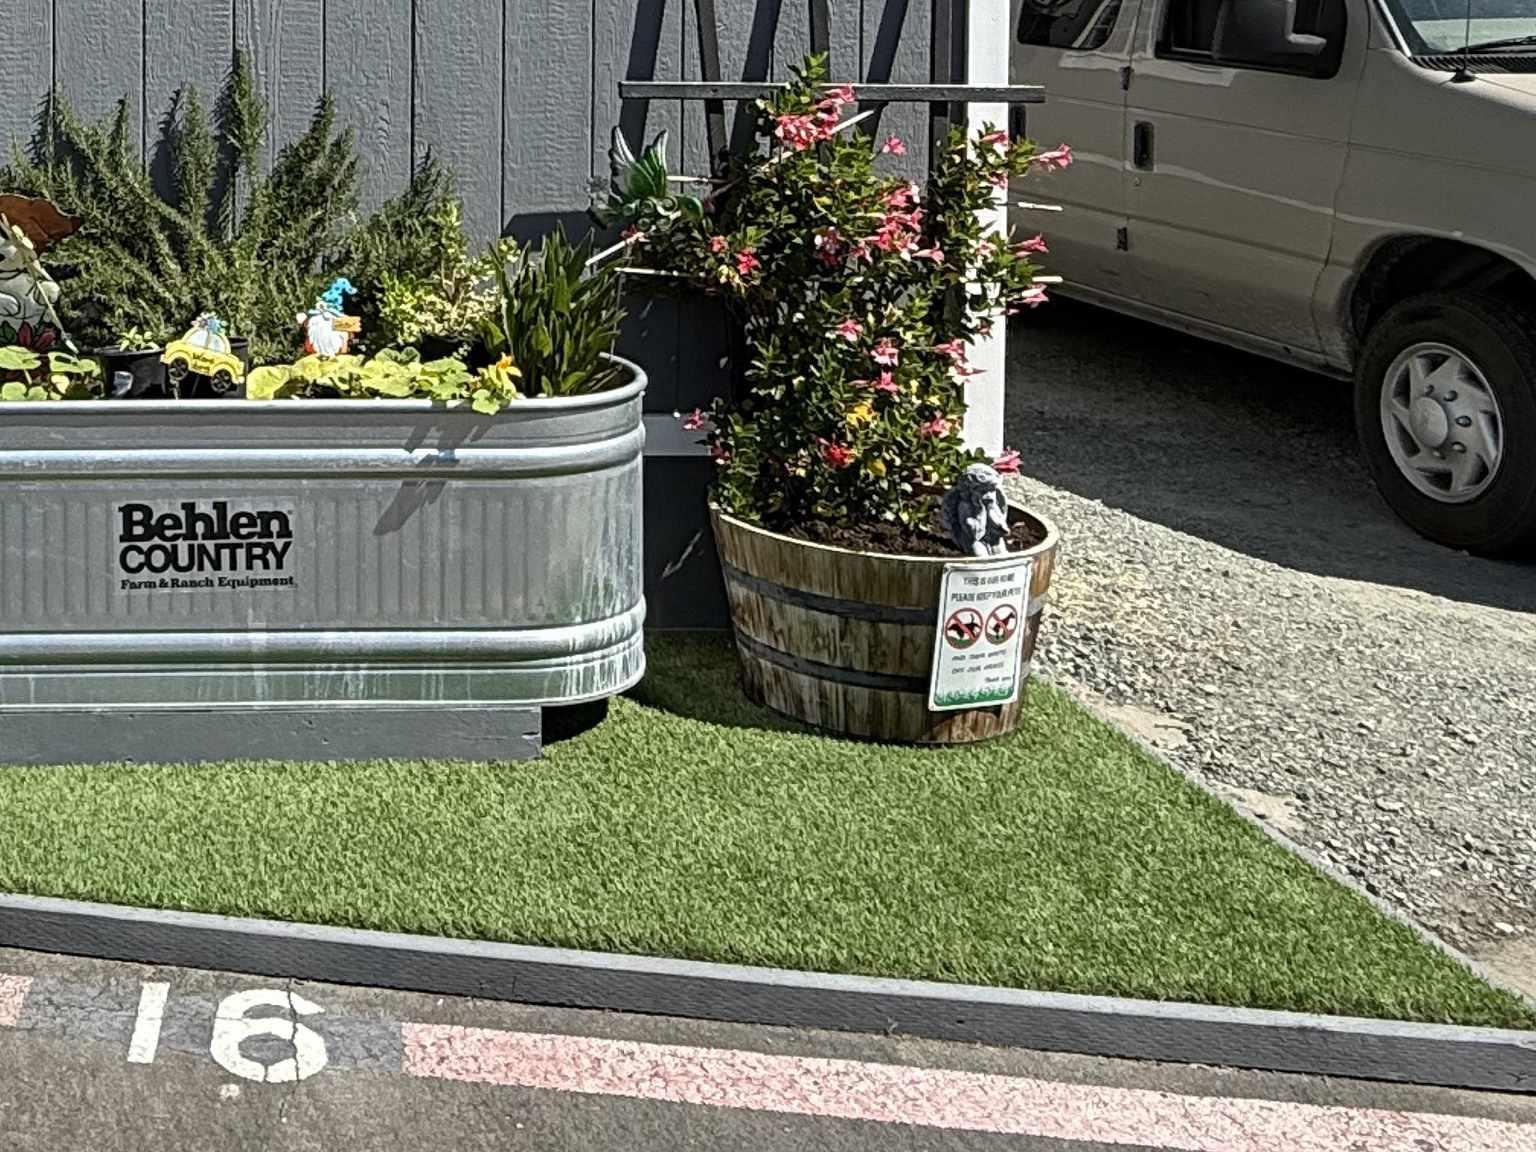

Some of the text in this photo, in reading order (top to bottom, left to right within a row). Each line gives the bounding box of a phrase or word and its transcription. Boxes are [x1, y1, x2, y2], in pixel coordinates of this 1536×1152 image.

[118, 501, 293, 542] Behlen
[119, 541, 292, 574] COUNTRY
[121, 575, 294, 590] Farm & Ranch Equipment
[127, 982, 328, 1084] 16
